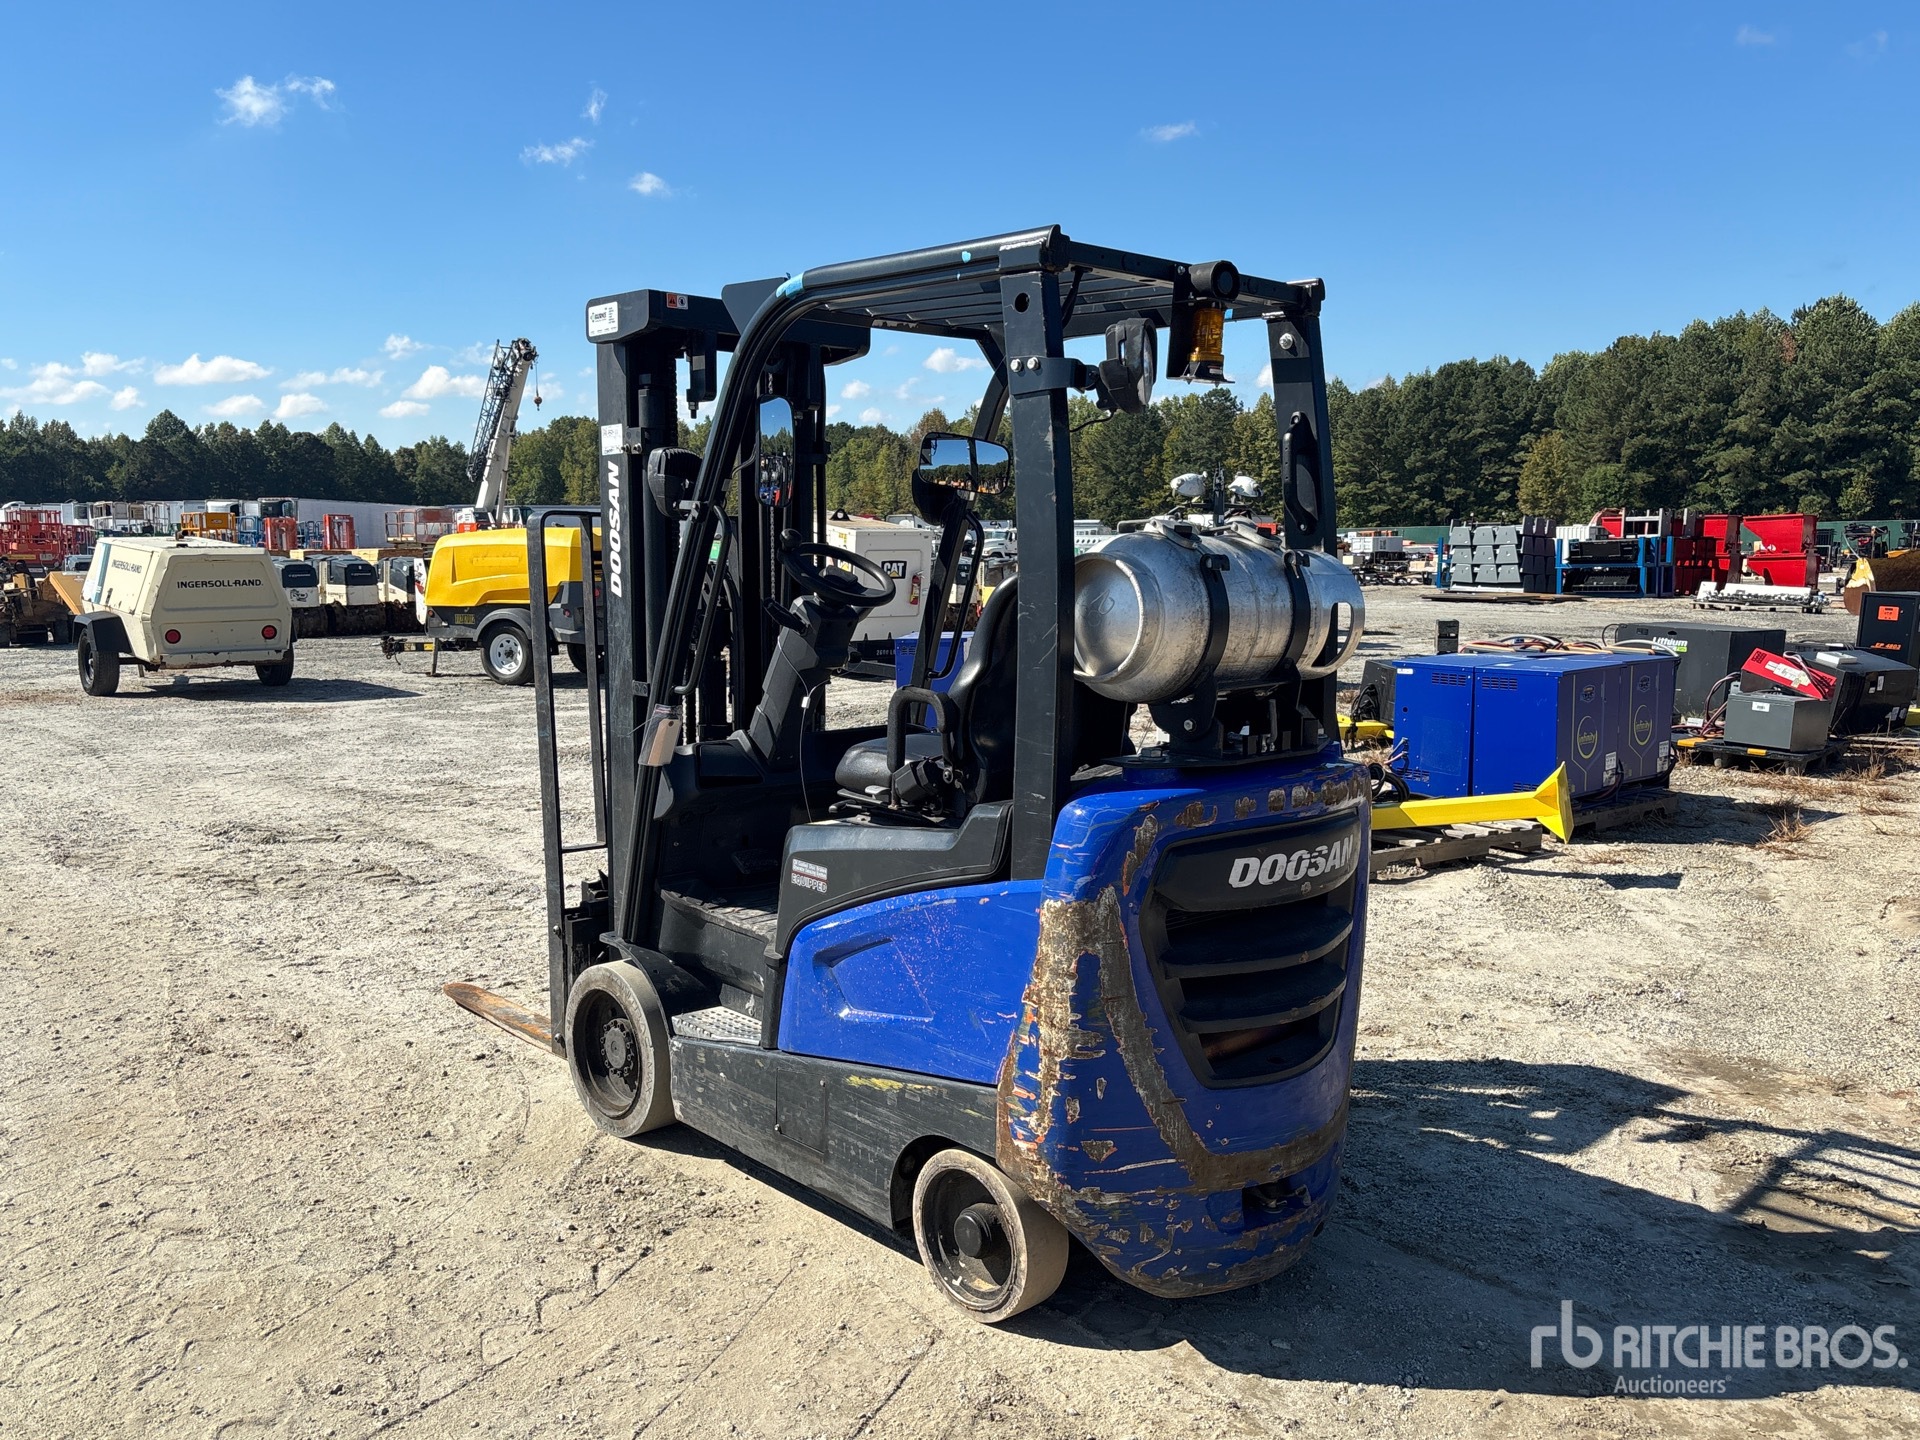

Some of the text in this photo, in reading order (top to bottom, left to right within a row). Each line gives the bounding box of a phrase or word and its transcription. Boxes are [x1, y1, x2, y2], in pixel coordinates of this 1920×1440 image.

[607, 460, 623, 598] DOOSAN
[883, 562, 904, 577] CAT
[176, 579, 262, 589] INGERSOLL-RAND
[1228, 834, 1354, 888] DOOSAN
[791, 872, 828, 893] EQUIPPED
